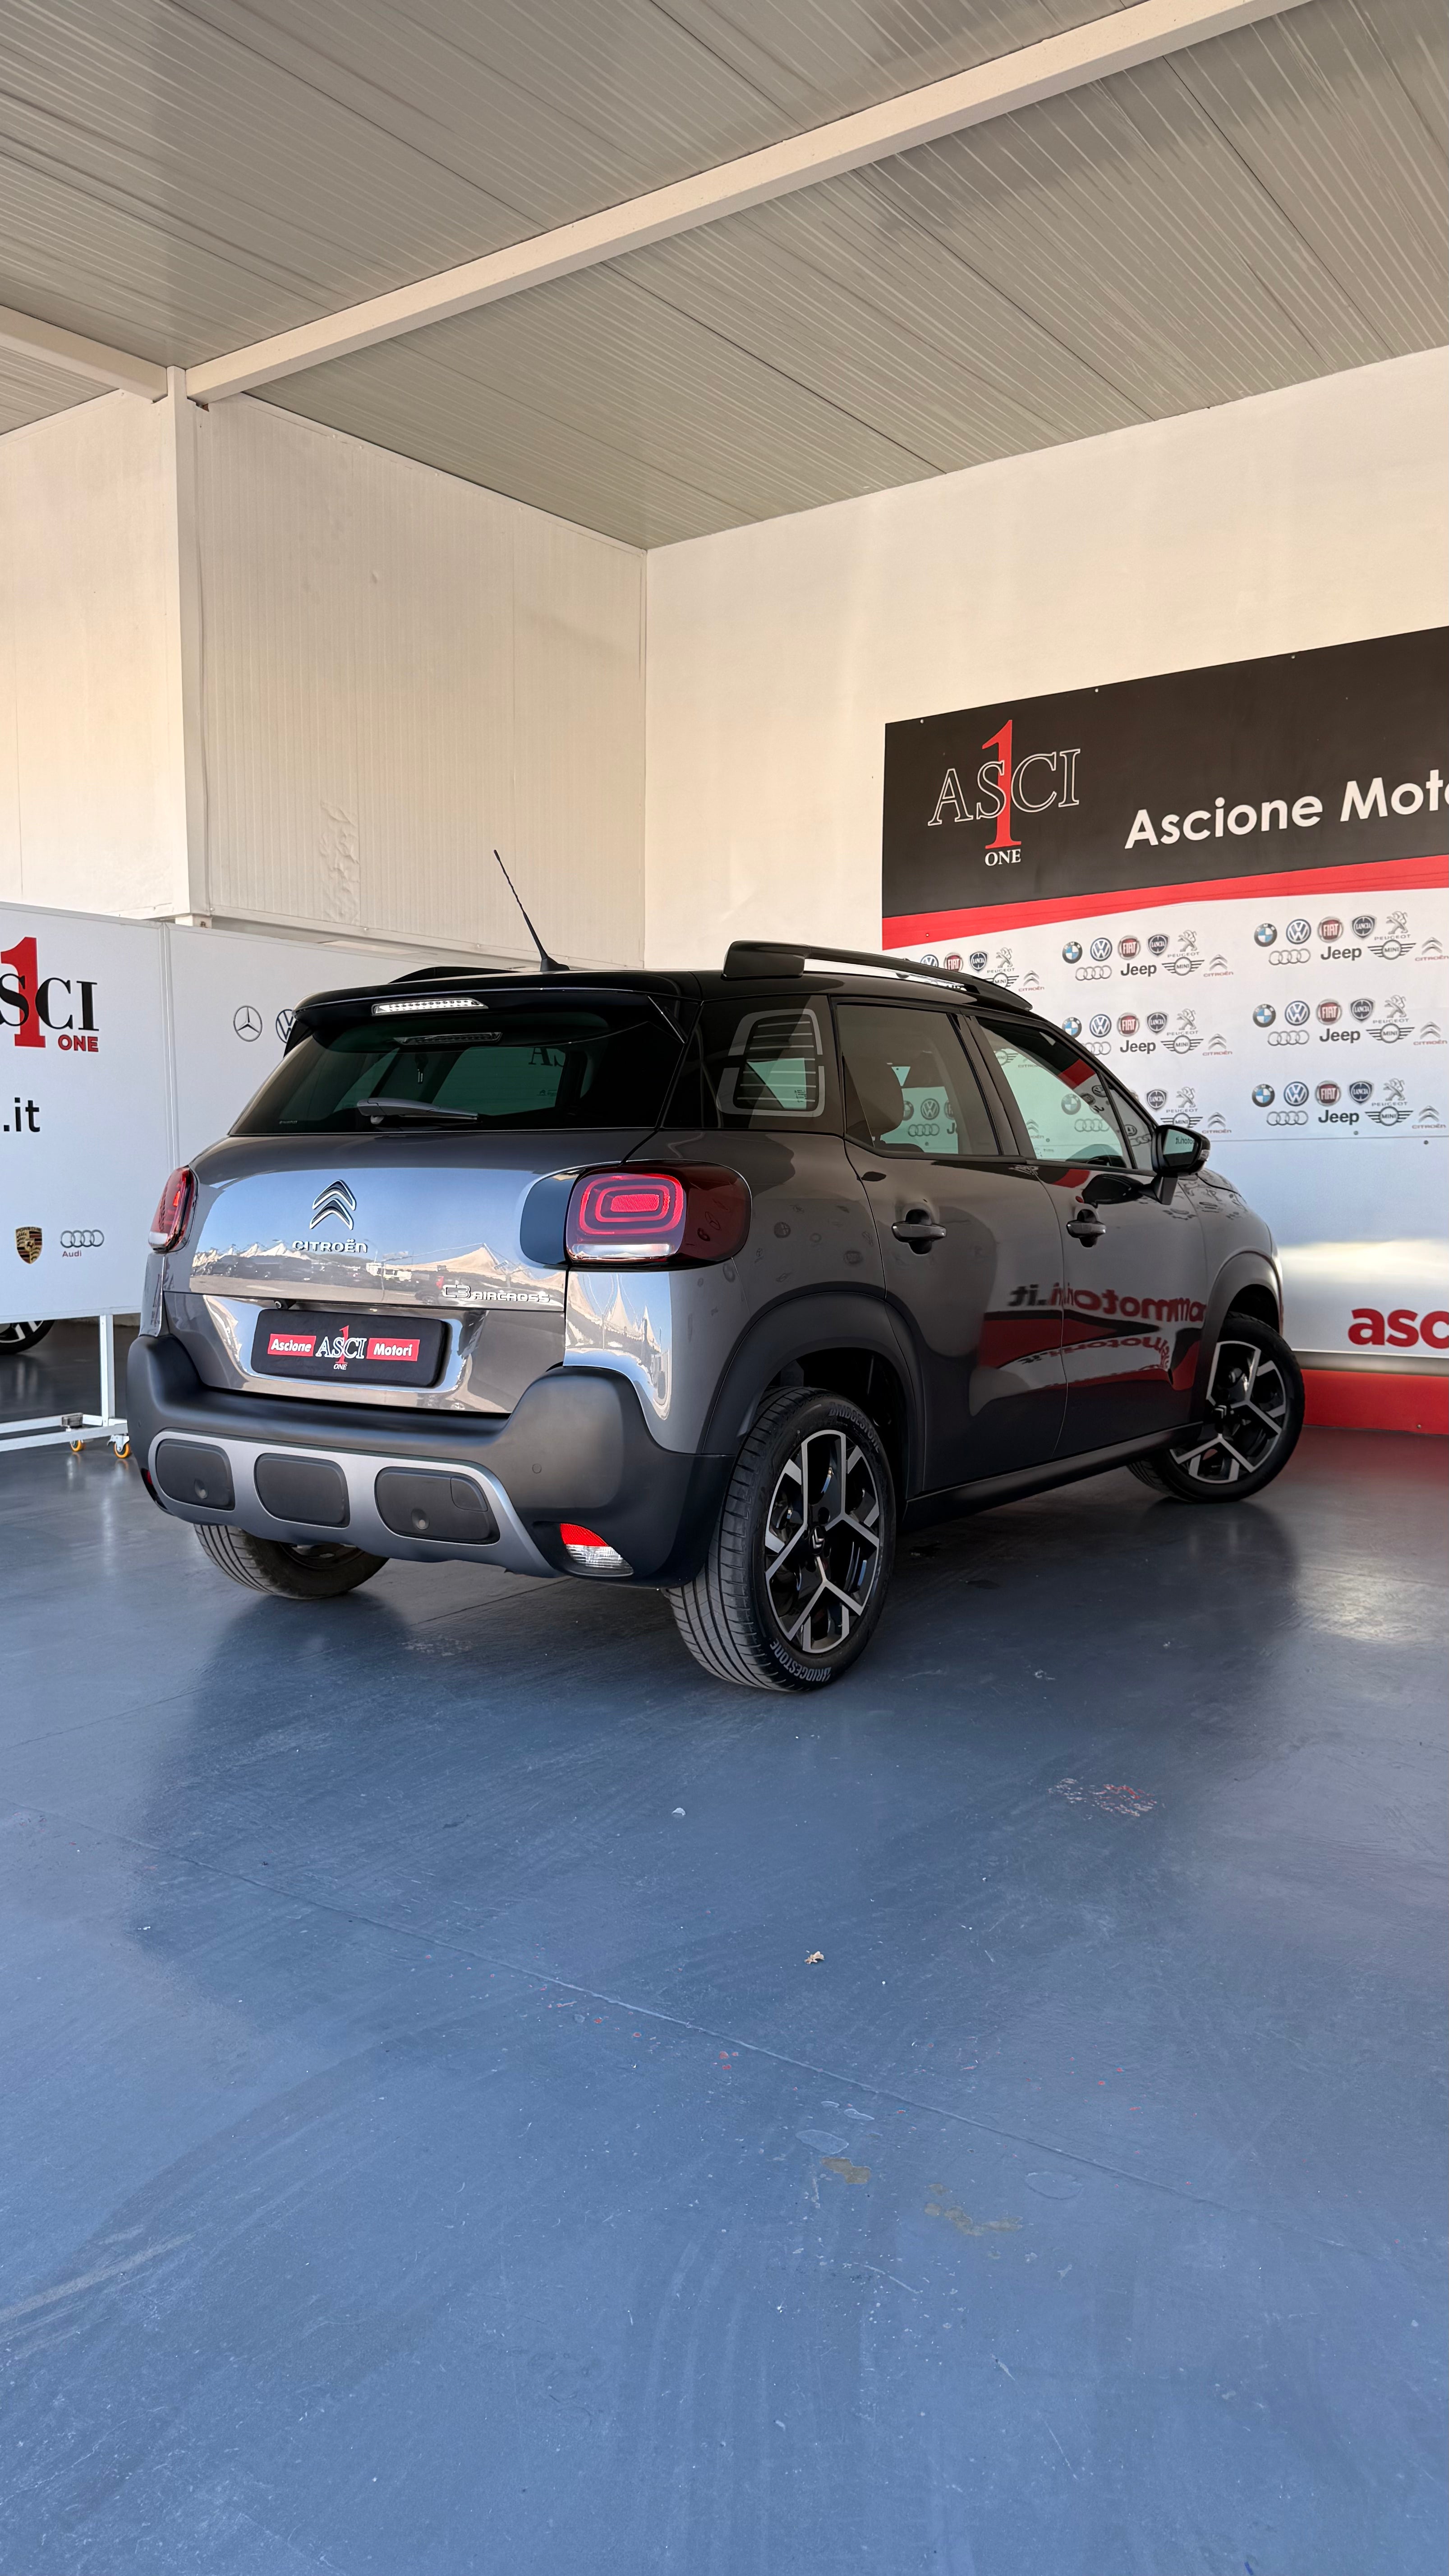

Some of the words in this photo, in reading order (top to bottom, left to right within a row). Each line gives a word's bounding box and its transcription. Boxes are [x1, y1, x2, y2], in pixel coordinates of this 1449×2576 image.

[928, 749, 1081, 826] ASCI
[1125, 796, 1323, 849] Ascione
[1340, 769, 1449, 822] Mot
[985, 849, 1021, 866] ONE
[1323, 923, 1339, 936] FIAT
[1122, 942, 1137, 954] FIAT
[1320, 946, 1362, 961] Jeep
[1121, 963, 1157, 977] Jeep
[0, 973, 99, 1031] SCI
[1322, 1006, 1338, 1018] FIAT
[1121, 1019, 1136, 1031] FIAT
[58, 1034, 99, 1052] ONE
[1319, 1028, 1361, 1043] Jeep
[1120, 1040, 1156, 1054] Jeep
[1320, 1087, 1336, 1100] FIAT
[4, 1097, 41, 1132] .it
[1318, 1110, 1360, 1125] Jeep
[442, 1285, 470, 1298] C3
[474, 1291, 550, 1302] AIRCROSS
[1348, 1308, 1449, 1349] asc
[271, 1339, 312, 1352] Ascione
[315, 1336, 367, 1359] ASCI
[373, 1343, 412, 1357] Motori
[828, 1402, 880, 1454] BRIDGESTONE
[770, 1638, 832, 1682] BRIDGESTONE
